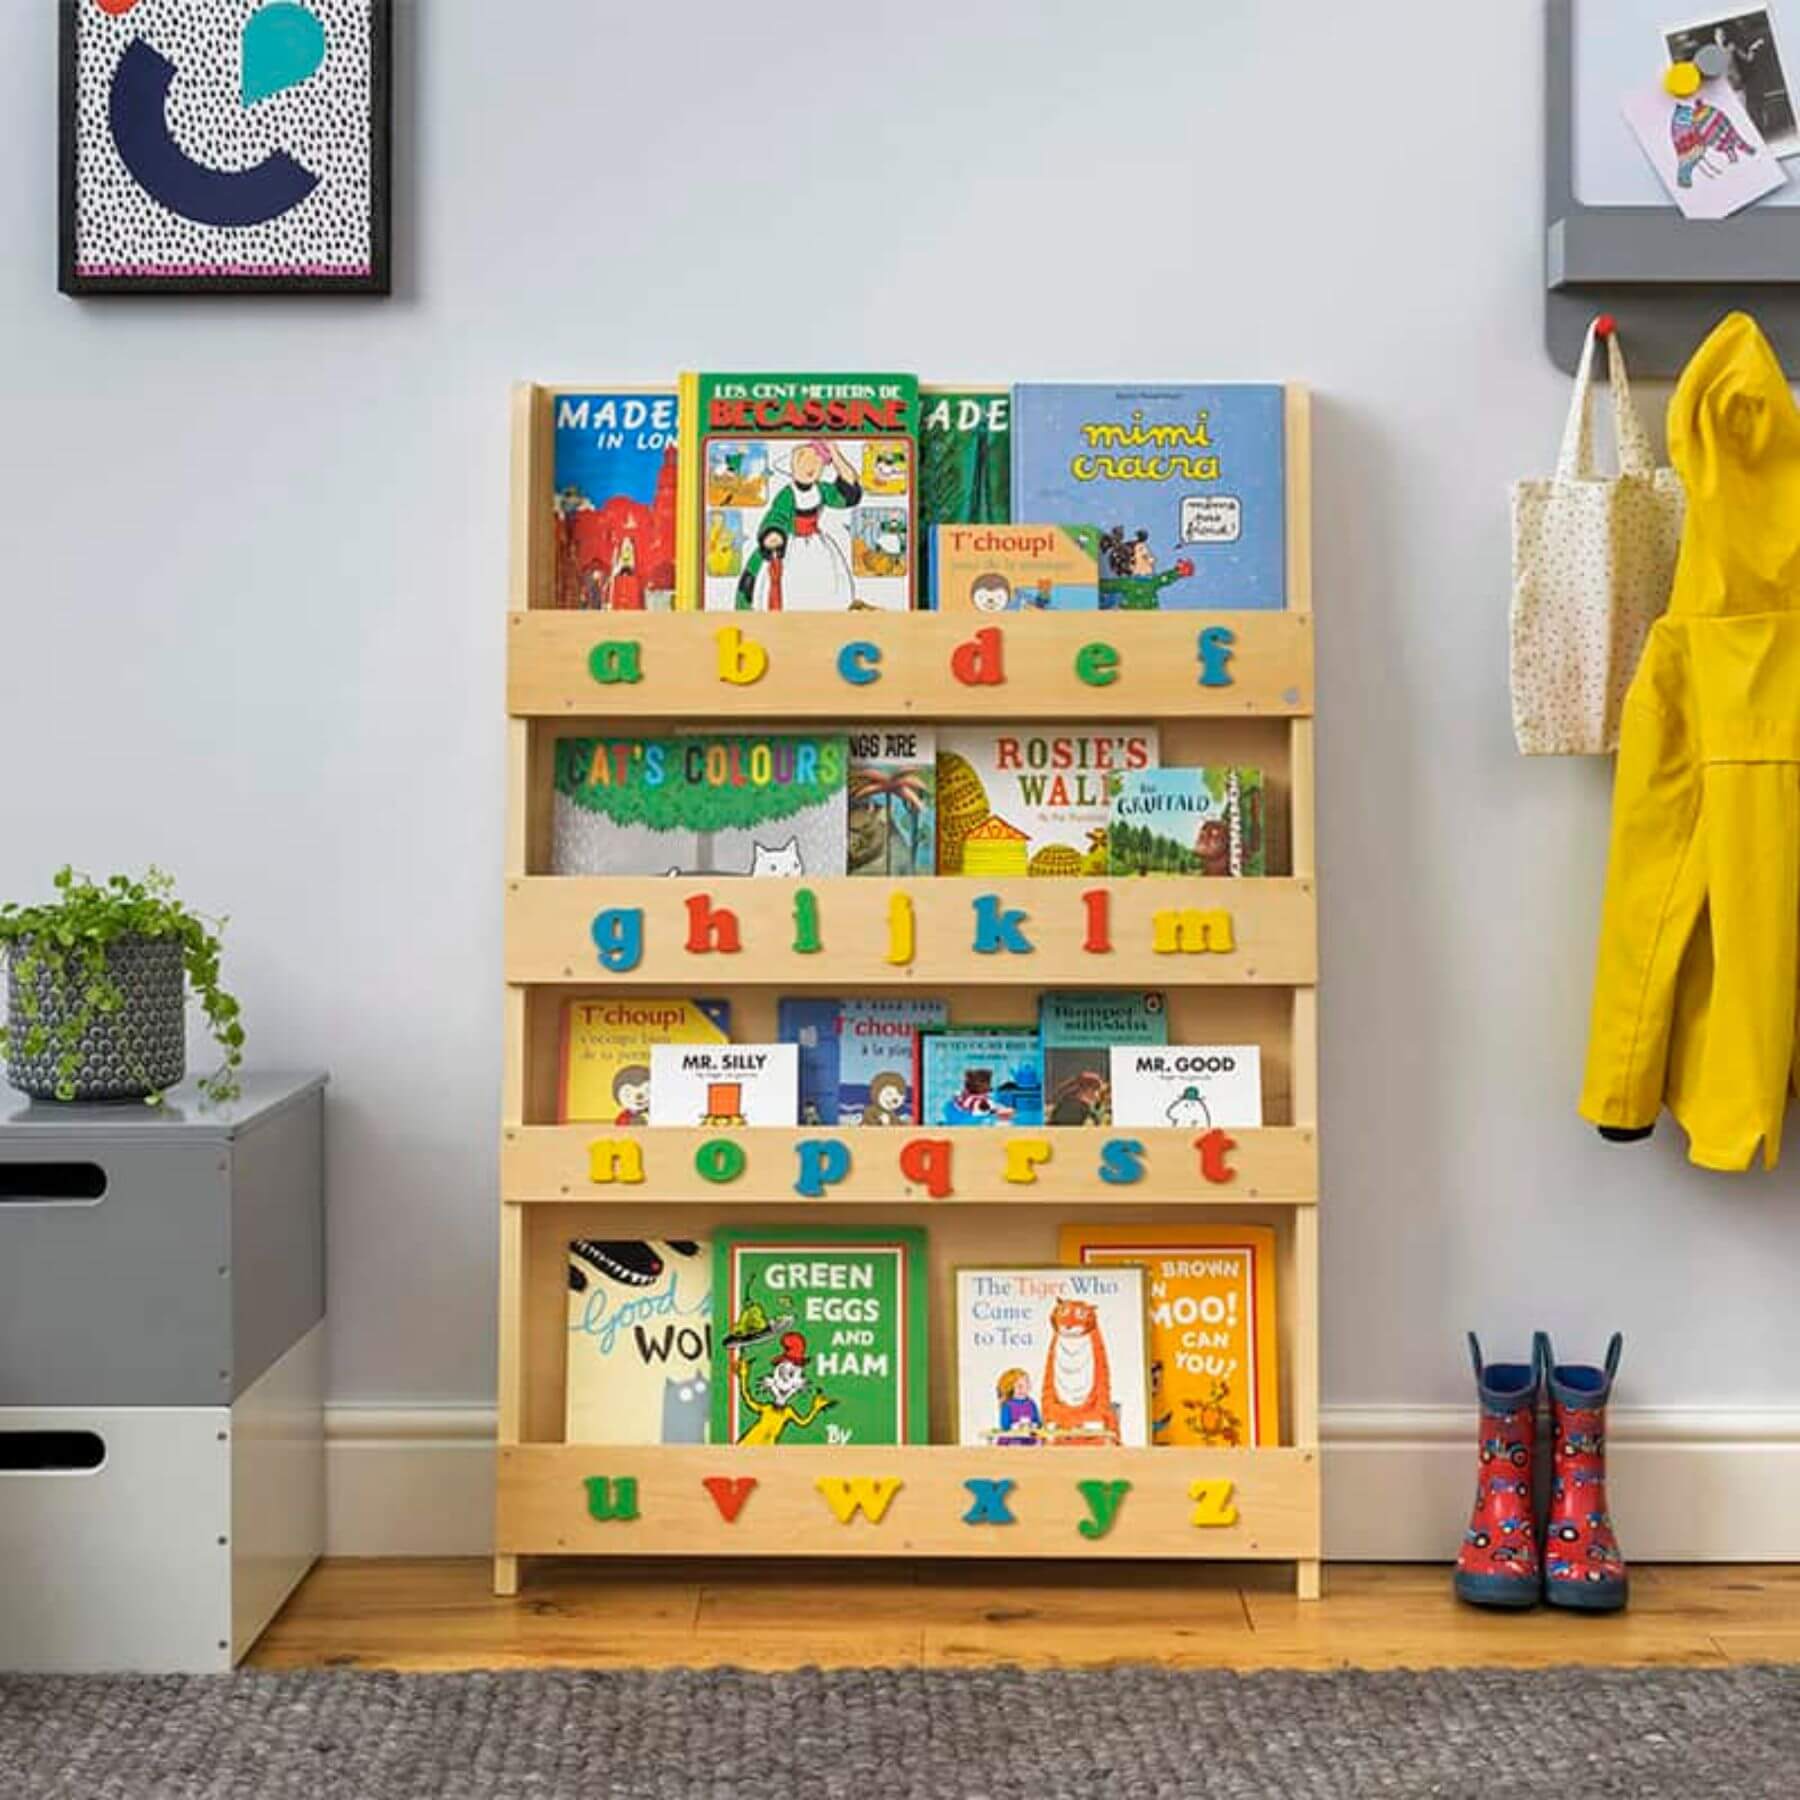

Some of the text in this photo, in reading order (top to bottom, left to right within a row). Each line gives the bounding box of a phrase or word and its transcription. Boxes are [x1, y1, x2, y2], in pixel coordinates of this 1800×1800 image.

[714, 383, 746, 398] LES
[752, 383, 798, 398] CENT
[879, 384, 902, 398] DE
[557, 400, 679, 429] MADE
[709, 400, 908, 431] BECASSINE
[920, 399, 1008, 431] ADE
[597, 432, 624, 450] IN
[1082, 409, 1212, 448] mimi
[1070, 455, 1221, 482] cracra
[950, 530, 1055, 558] T'choupi
[589, 626, 1235, 687] a b c d e f
[885, 735, 917, 758] ARE
[997, 736, 1148, 770] ROSIE'S
[568, 744, 841, 788] CAT'S COLOURS
[592, 888, 1236, 971] g h i j k l m
[580, 1006, 685, 1031] T'choupi
[682, 1054, 767, 1070] MR. SILLY
[1136, 1057, 1236, 1072] MR. GOOD
[588, 1128, 1237, 1198] n o p q r s t
[764, 1263, 874, 1290] GREEN
[1161, 1259, 1240, 1279] BROWN
[972, 1275, 1119, 1301] The Tiger Who
[805, 1297, 880, 1322] EGGS
[972, 1301, 1033, 1320] Came
[831, 1330, 875, 1346] AND
[974, 1327, 1033, 1346] to Tea
[1181, 1331, 1230, 1349] CAN
[816, 1352, 888, 1377] HAM
[825, 1423, 853, 1444] By
[584, 1475, 1239, 1539] u v w x y z
